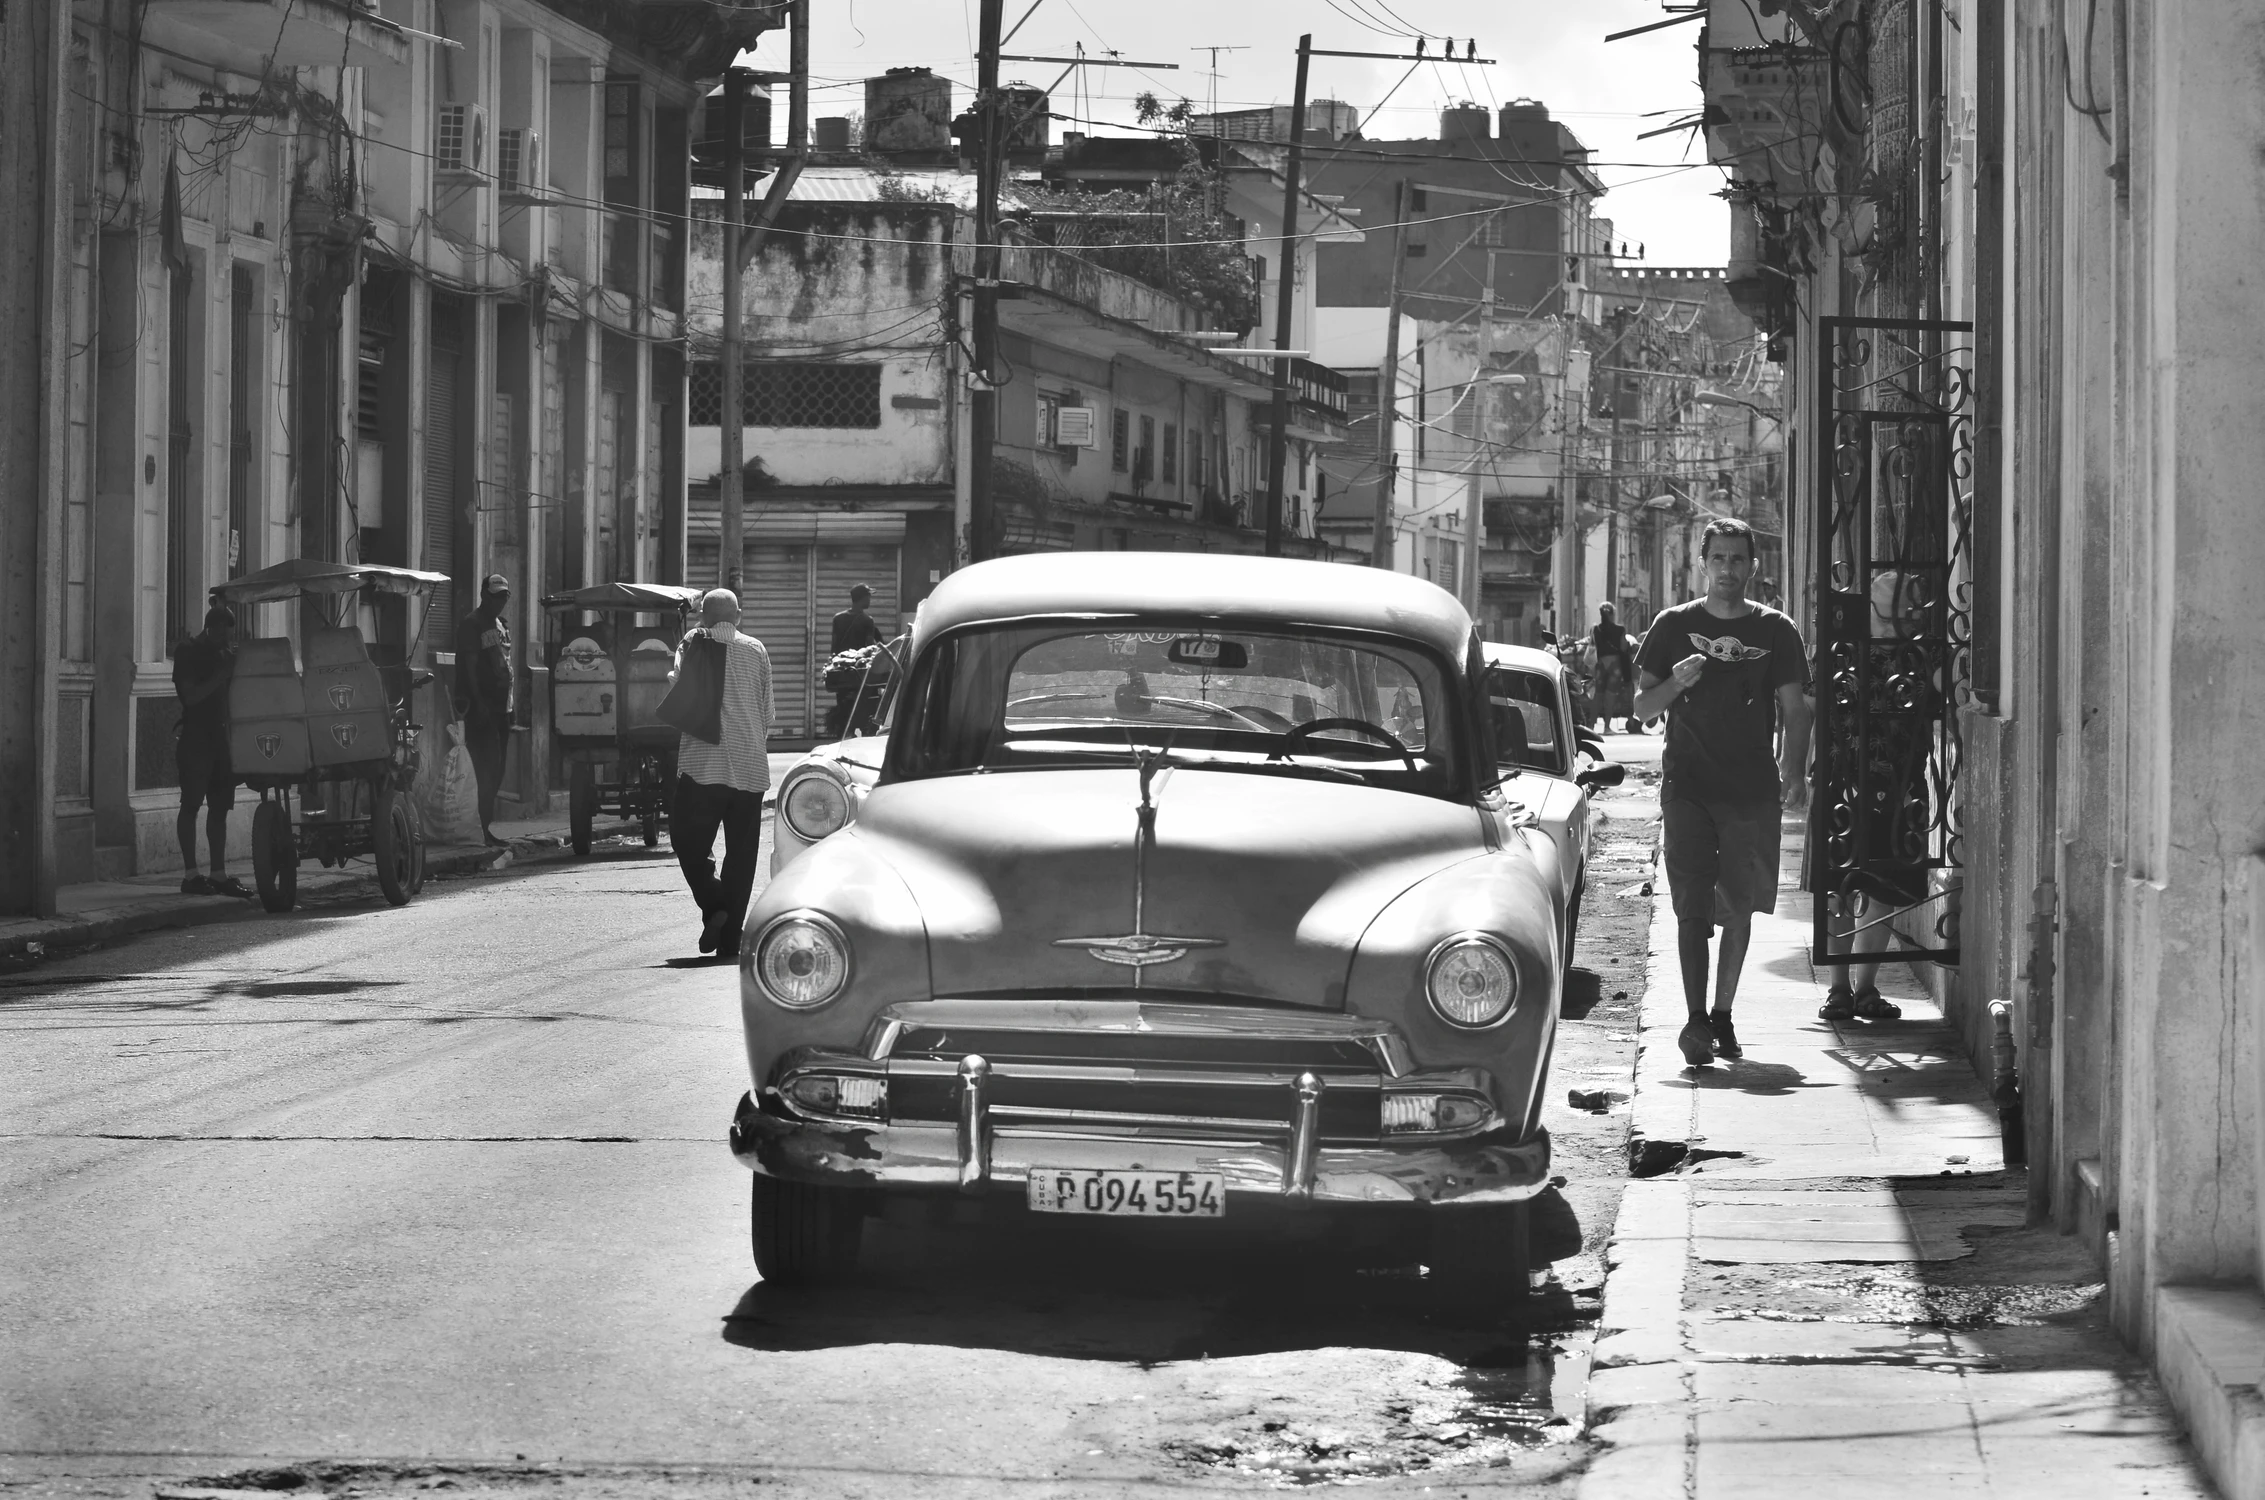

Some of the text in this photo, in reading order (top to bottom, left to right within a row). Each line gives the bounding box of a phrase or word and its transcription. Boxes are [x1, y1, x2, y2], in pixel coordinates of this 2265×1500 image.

[1038, 1175, 1046, 1206] CUBA
[1056, 1176, 1219, 1215] P 094 554
